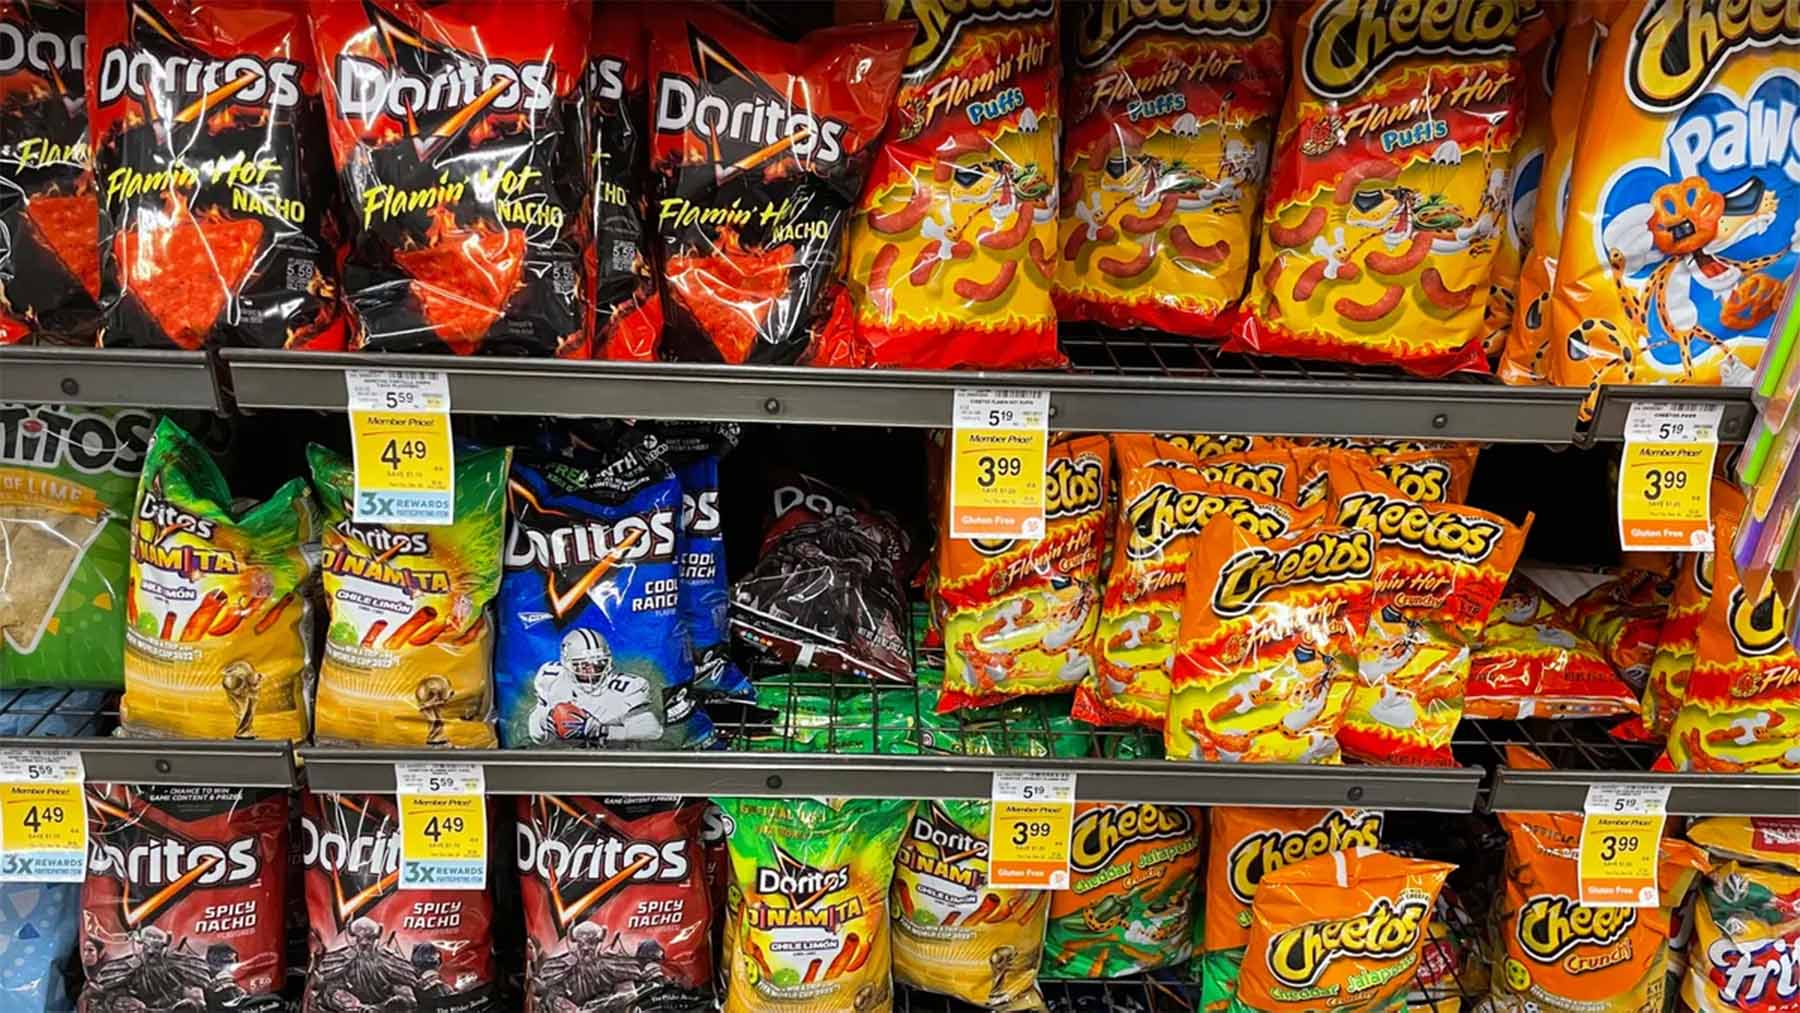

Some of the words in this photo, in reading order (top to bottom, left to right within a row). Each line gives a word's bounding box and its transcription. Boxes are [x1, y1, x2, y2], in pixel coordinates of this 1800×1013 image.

[1017, 36, 1050, 73] Hot
[1188, 50, 1242, 80] Hot
[101, 50, 300, 104] Doritos
[337, 55, 554, 116] Doritos
[1453, 73, 1515, 108] Hot
[656, 76, 847, 162] Doritos
[966, 88, 1024, 125] Puffs
[1128, 95, 1186, 121] Puffs
[1380, 119, 1449, 153] Puffs
[232, 191, 305, 224] NACHO
[497, 200, 563, 229] NACHO
[772, 220, 829, 241] NACHO
[396, 499, 449, 509] REWARDS
[1215, 534, 1372, 608] Cheetos
[516, 821, 689, 880] Doritos
[914, 820, 989, 857] Dorito
[436, 866, 484, 876] REWARDS
[759, 866, 849, 894] Doritos
[204, 900, 256, 919] SPICY
[402, 914, 461, 929] NACHO
[413, 900, 462, 915] SPICY
[628, 911, 683, 929] NACHO
[637, 899, 684, 914] SPICY
[194, 913, 257, 933] NACHO
[1271, 905, 1422, 982] Cheetos
